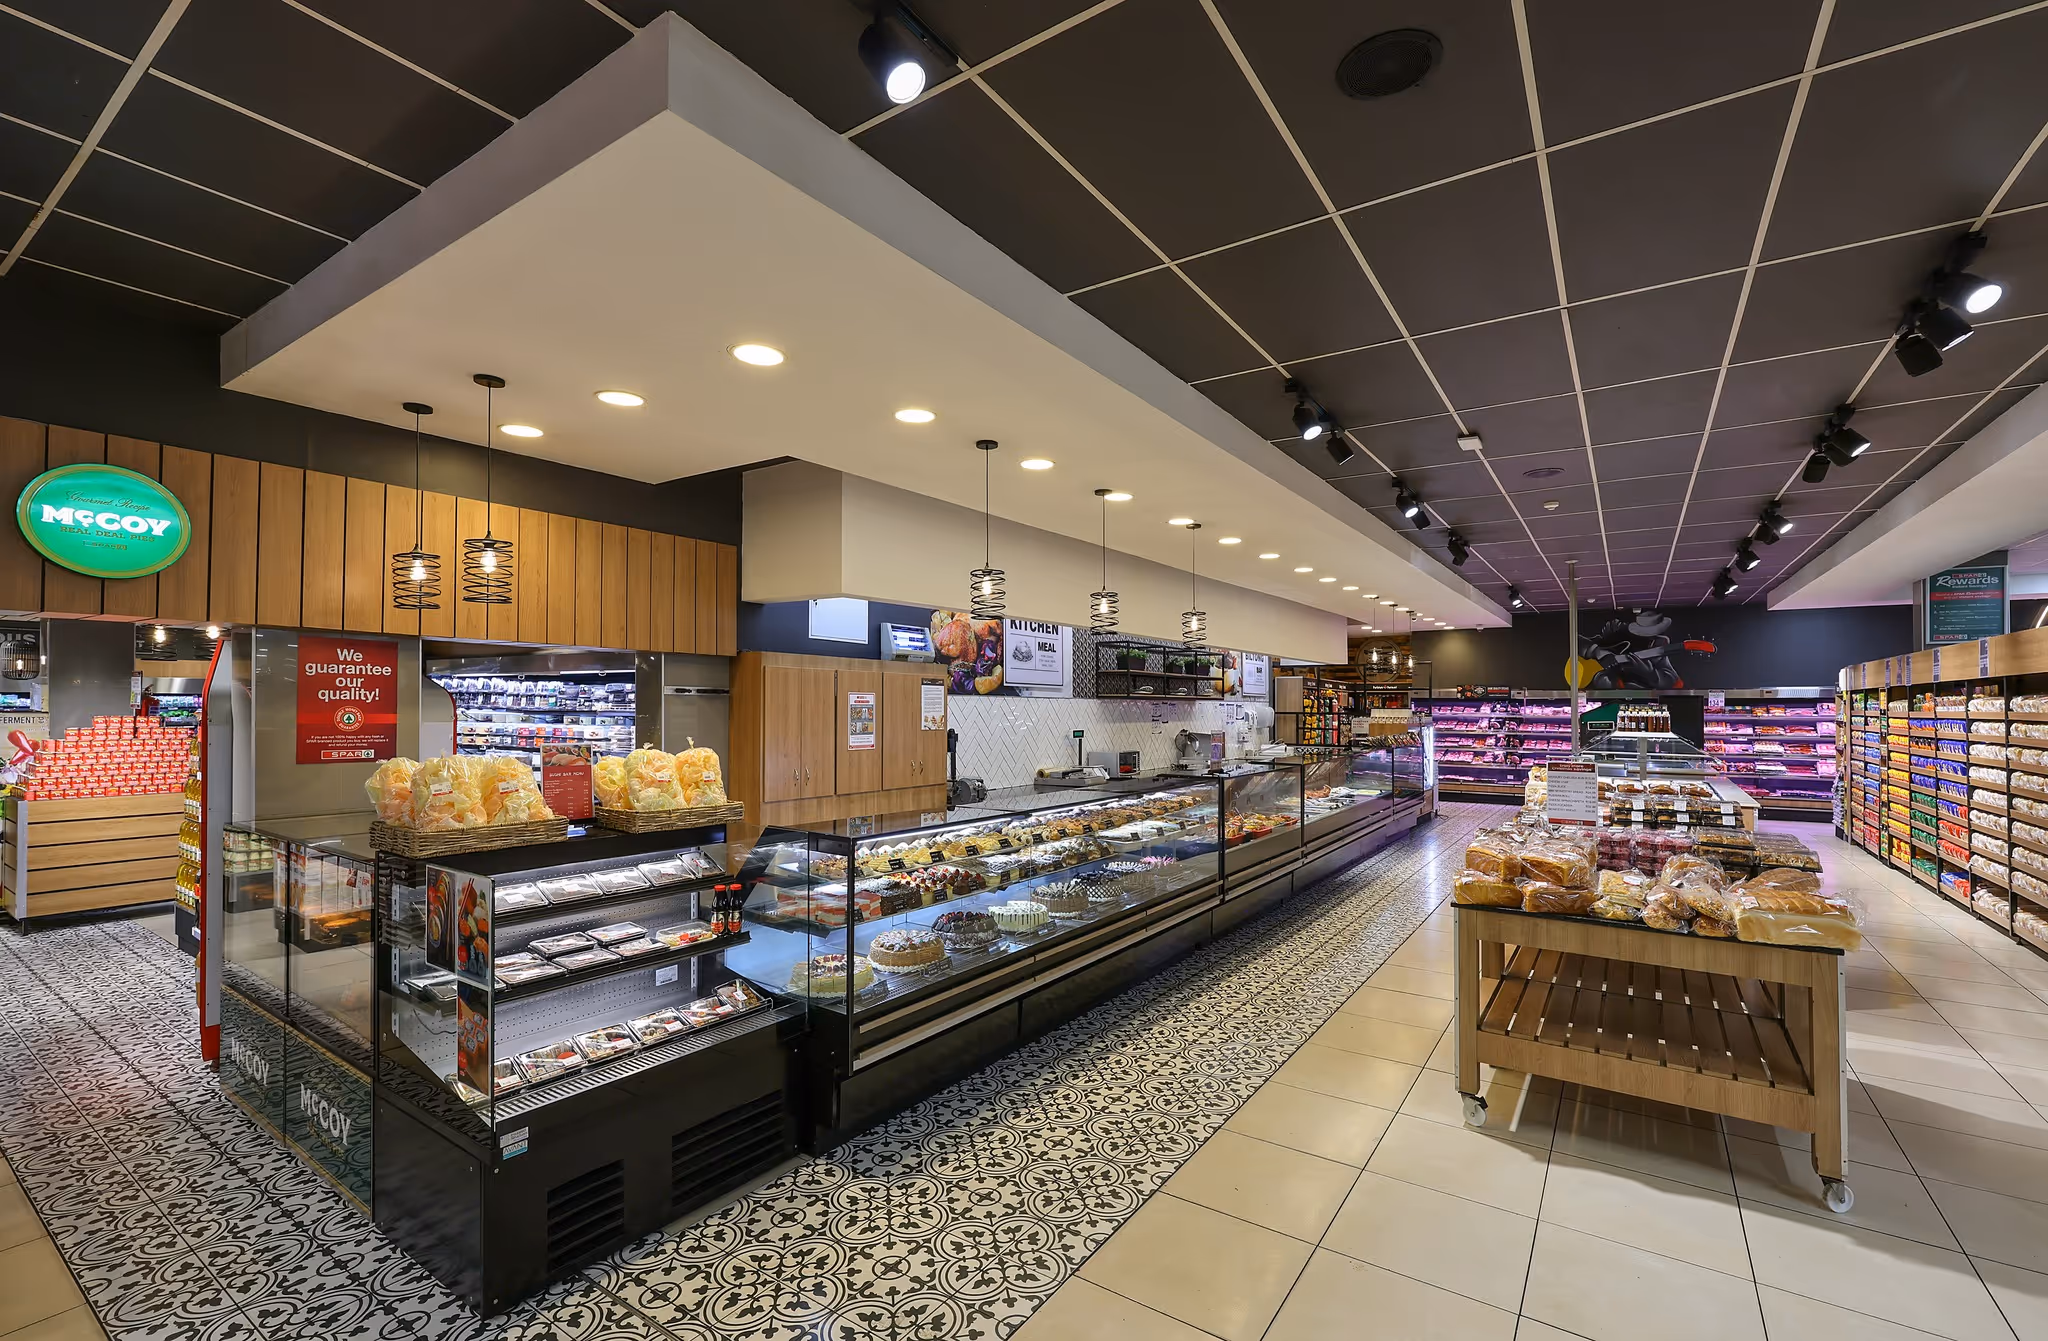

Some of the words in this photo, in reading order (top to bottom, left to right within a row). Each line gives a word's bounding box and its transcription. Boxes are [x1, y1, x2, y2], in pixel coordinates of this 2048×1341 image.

[60, 526, 91, 535] REAL
[95, 530, 126, 539] DEAL
[129, 533, 155, 542] PIES
[1936, 576, 1999, 587] Rewards
[1010, 619, 1059, 635] KITCHEN
[1038, 642, 1056, 653] MEAL
[336, 648, 363, 662] We
[305, 663, 392, 675] guarantee
[335, 677, 364, 687] our
[317, 688, 380, 703] quality!
[300, 1082, 352, 1146] McCOY
